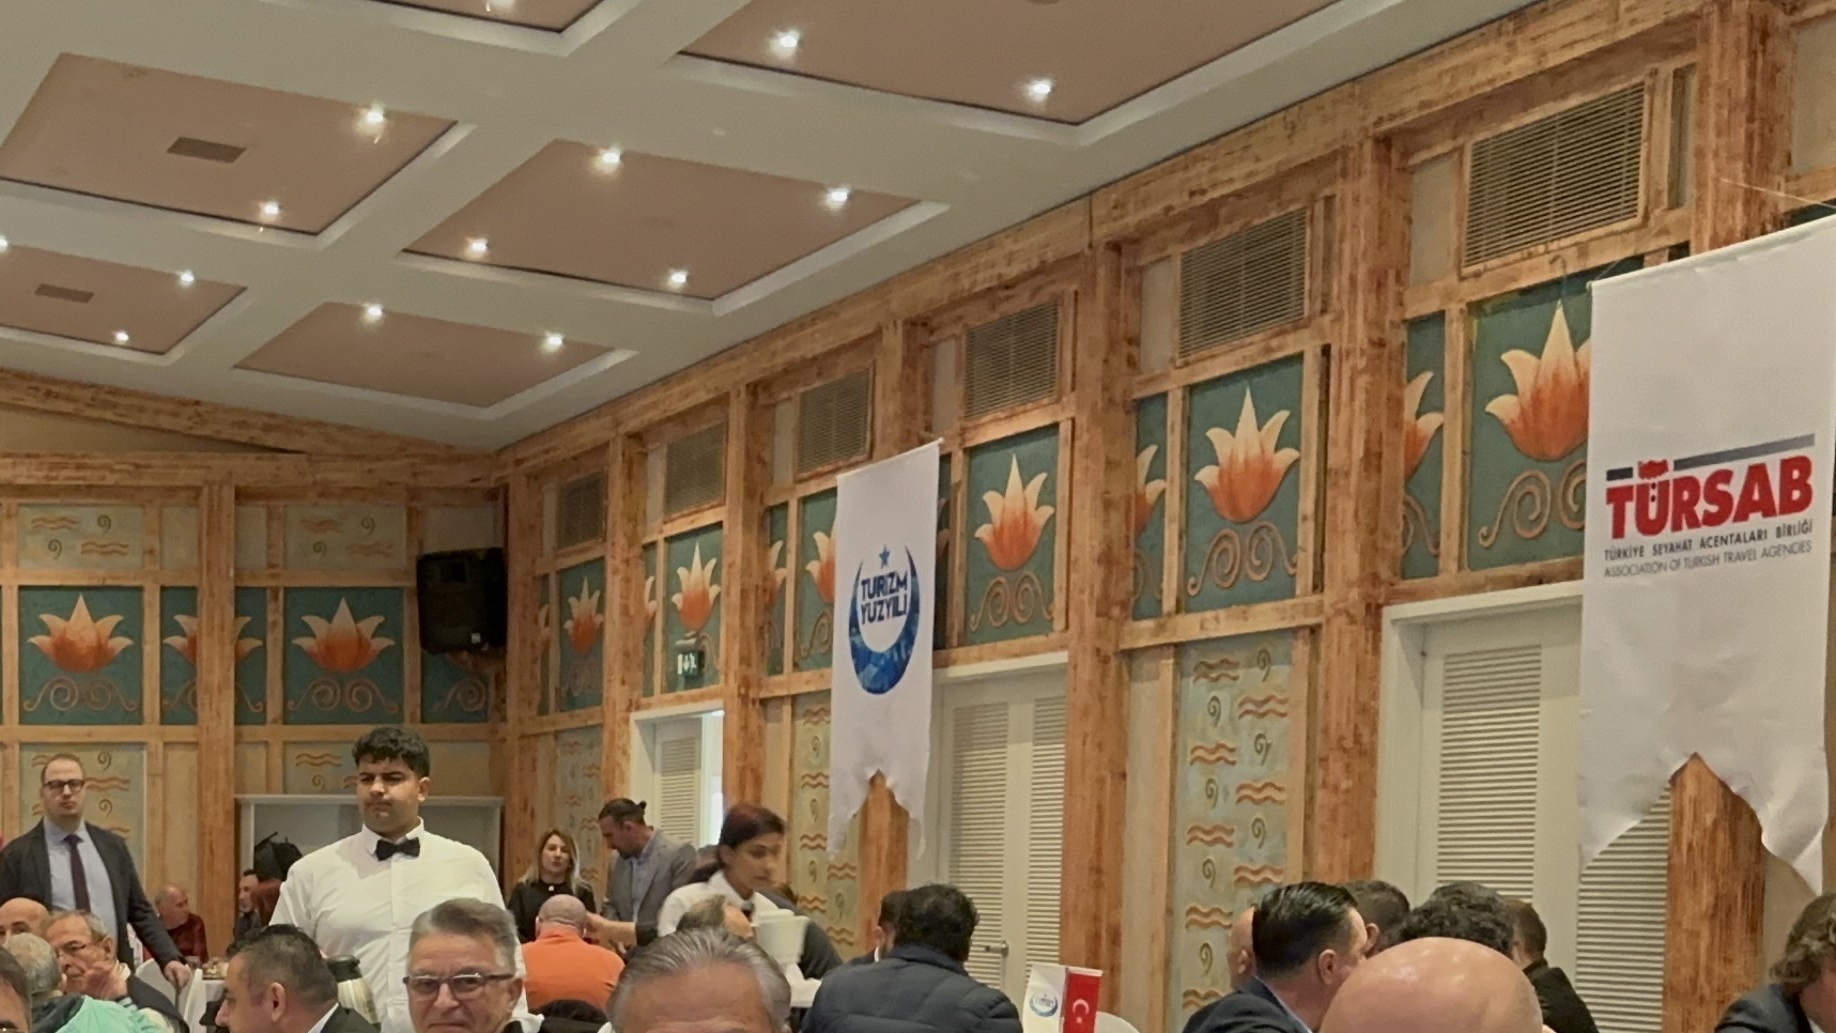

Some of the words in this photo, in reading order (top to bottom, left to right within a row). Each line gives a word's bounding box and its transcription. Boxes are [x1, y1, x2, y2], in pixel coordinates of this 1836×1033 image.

[1606, 455, 1813, 540] TÜRSAB
[1604, 545, 1645, 561] TÜRKİYE
[1652, 539, 1693, 556] SEYAHAT
[1699, 528, 1768, 549] ACENTALARI
[1604, 560, 1668, 577] ASSOCIATION
[1669, 558, 1681, 571] OF
[1684, 552, 1720, 569] TURKISH
[1724, 548, 1757, 563] TRAVEL
[1761, 539, 1812, 558] AGENCIES
